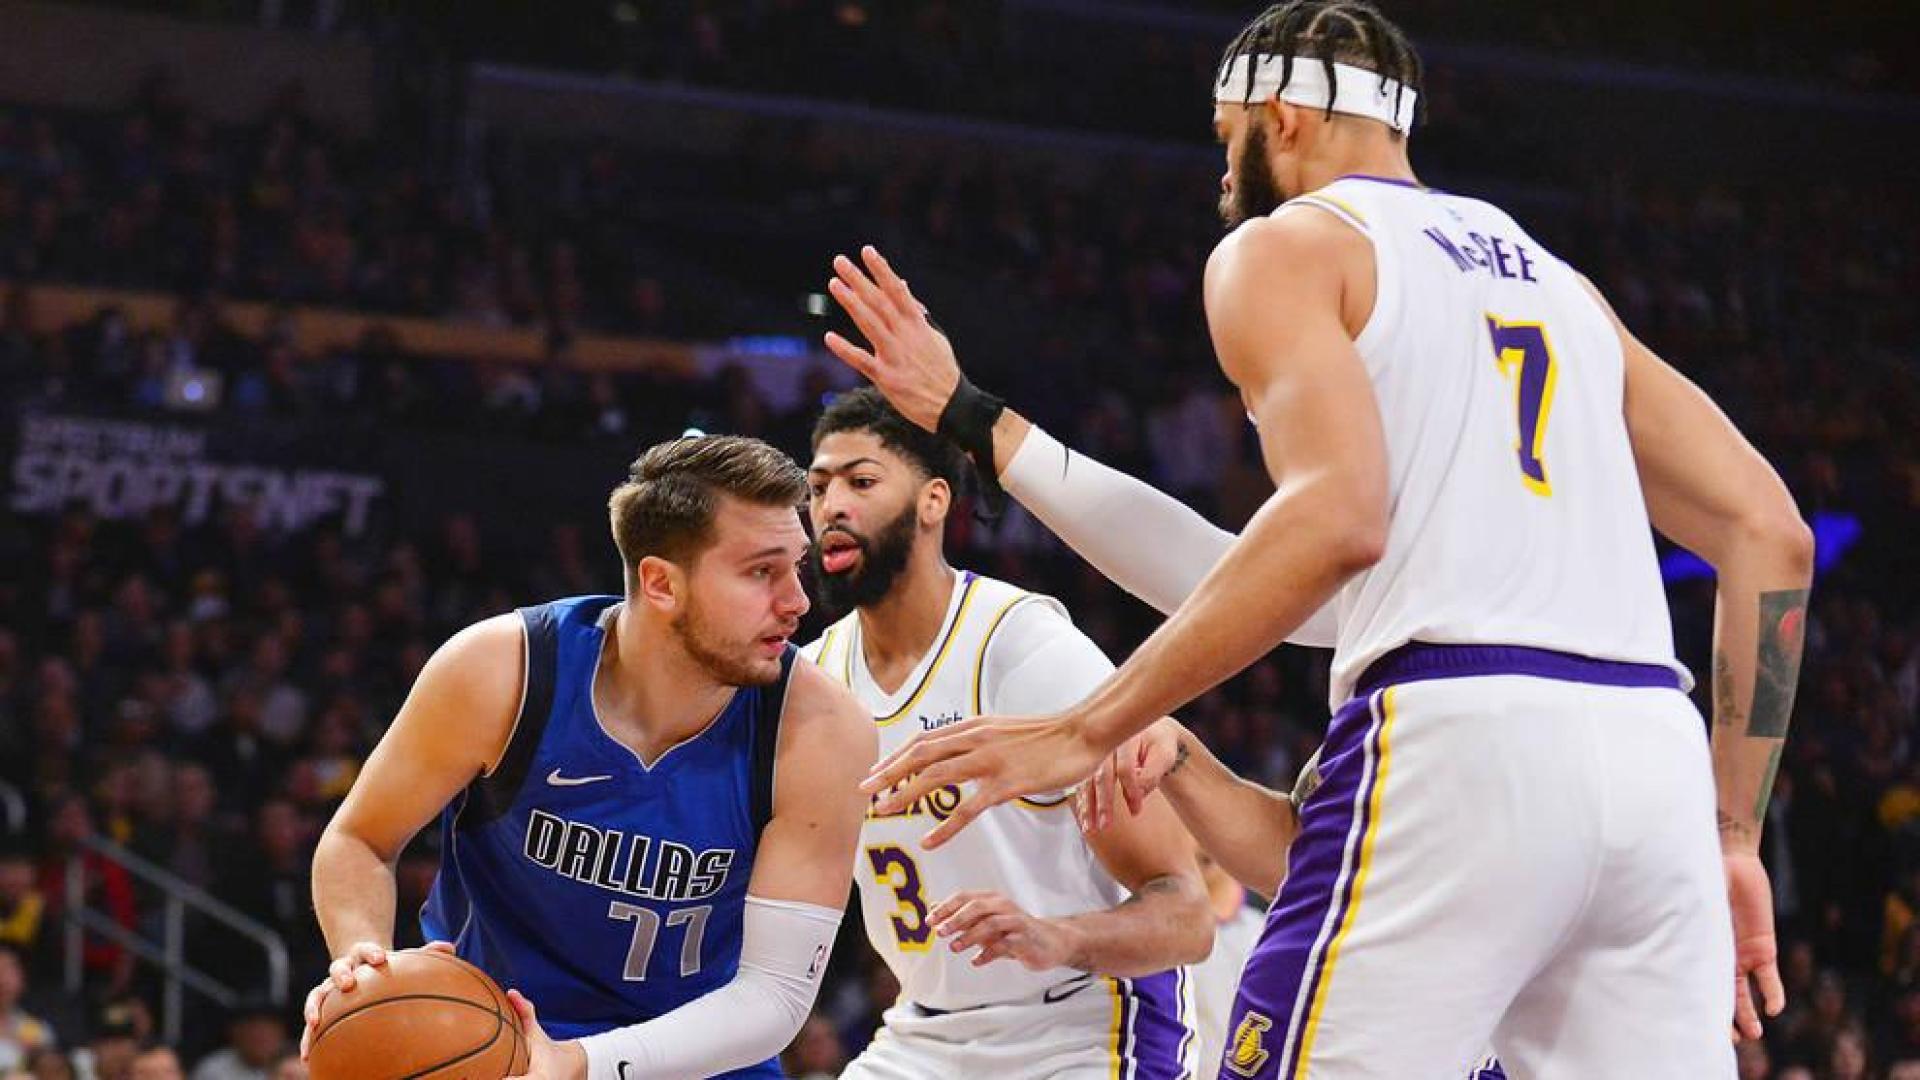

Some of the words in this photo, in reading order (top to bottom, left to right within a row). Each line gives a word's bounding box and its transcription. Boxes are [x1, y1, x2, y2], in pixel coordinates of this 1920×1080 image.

[1485, 311, 1559, 497] 7
[524, 808, 735, 901] DALLAS
[866, 842, 936, 951] 3
[607, 901, 713, 982] 77
